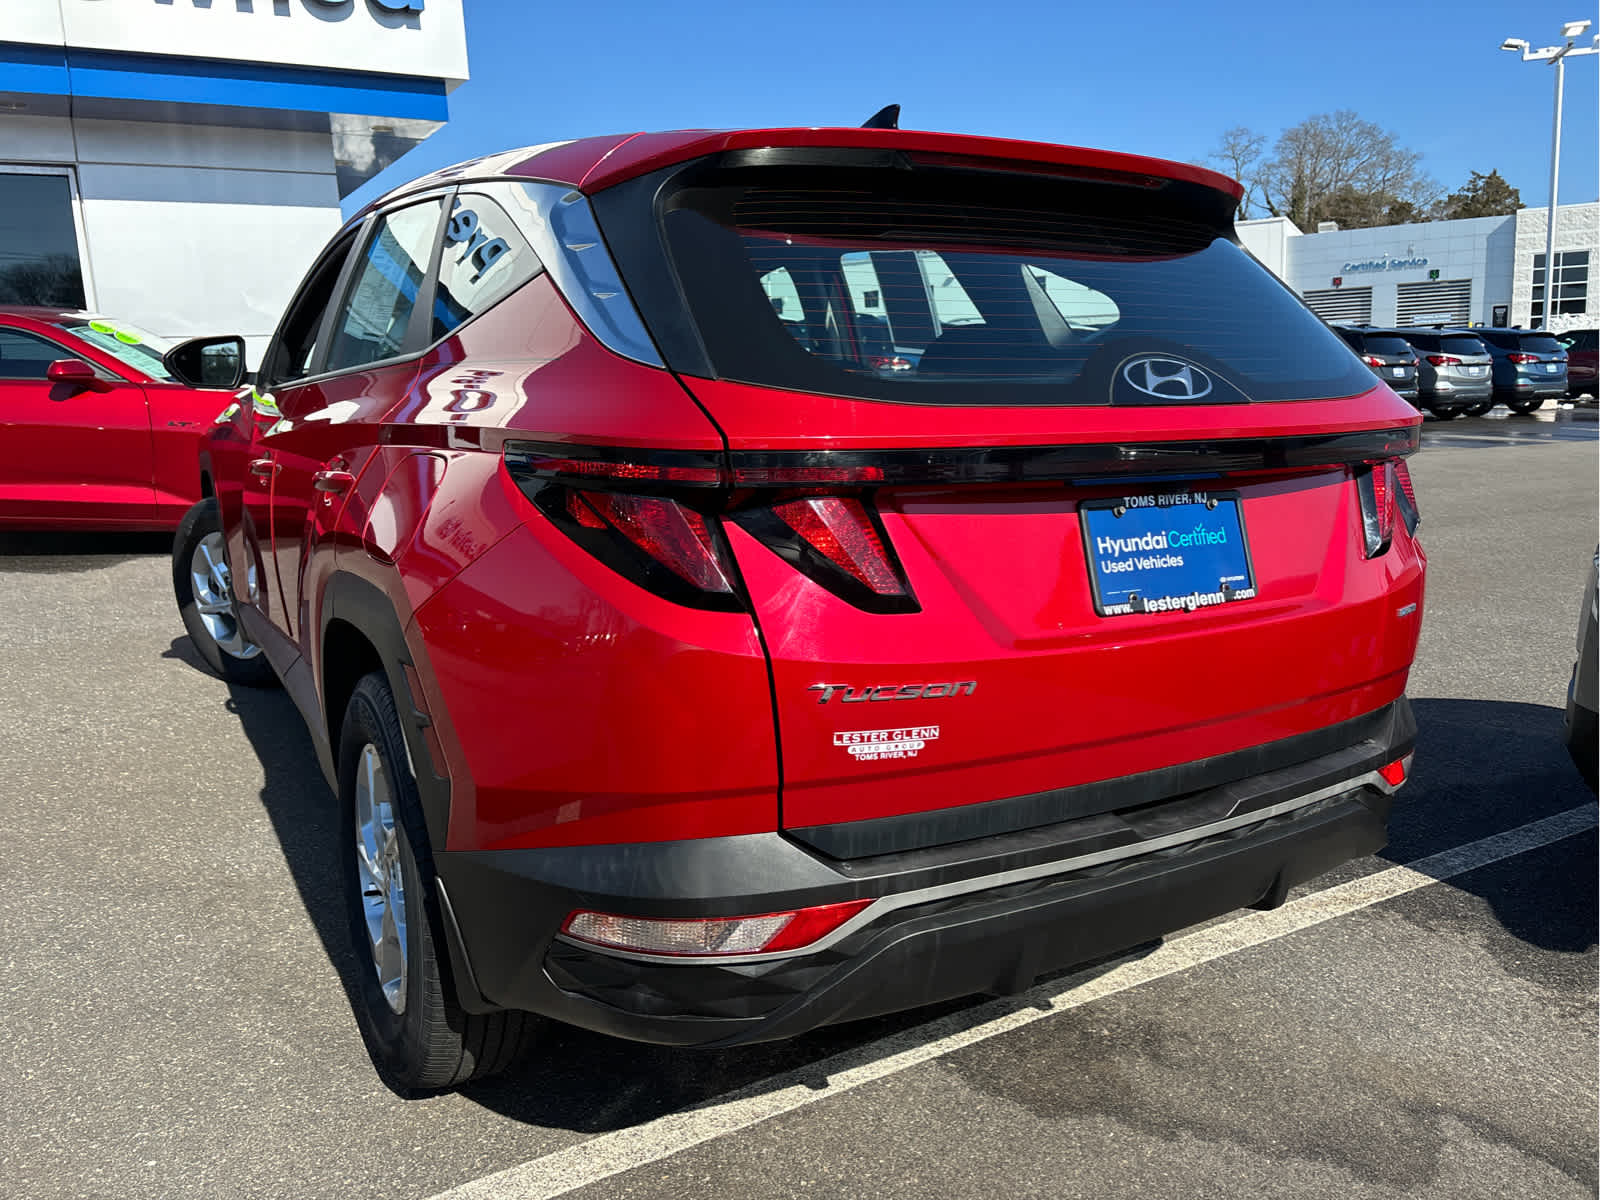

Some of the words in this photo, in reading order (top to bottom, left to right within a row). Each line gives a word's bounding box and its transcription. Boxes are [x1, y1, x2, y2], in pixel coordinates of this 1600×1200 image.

[1123, 495, 1156, 508] TOMS
[1158, 493, 1192, 506] RIVER,
[1194, 492, 1207, 503] NJ
[1097, 531, 1168, 557] Hyundai
[1168, 524, 1226, 548] Certified
[1101, 560, 1134, 573] Used
[1134, 554, 1184, 570] Vehicles
[1143, 591, 1225, 613] lesterglenn
[833, 732, 889, 744] LESTER
[892, 727, 940, 741] GLENN
[851, 745, 881, 753] AUTO
[855, 752, 879, 761] TOMS
[880, 750, 907, 760] RIVER,
[908, 749, 918, 758] NJ
